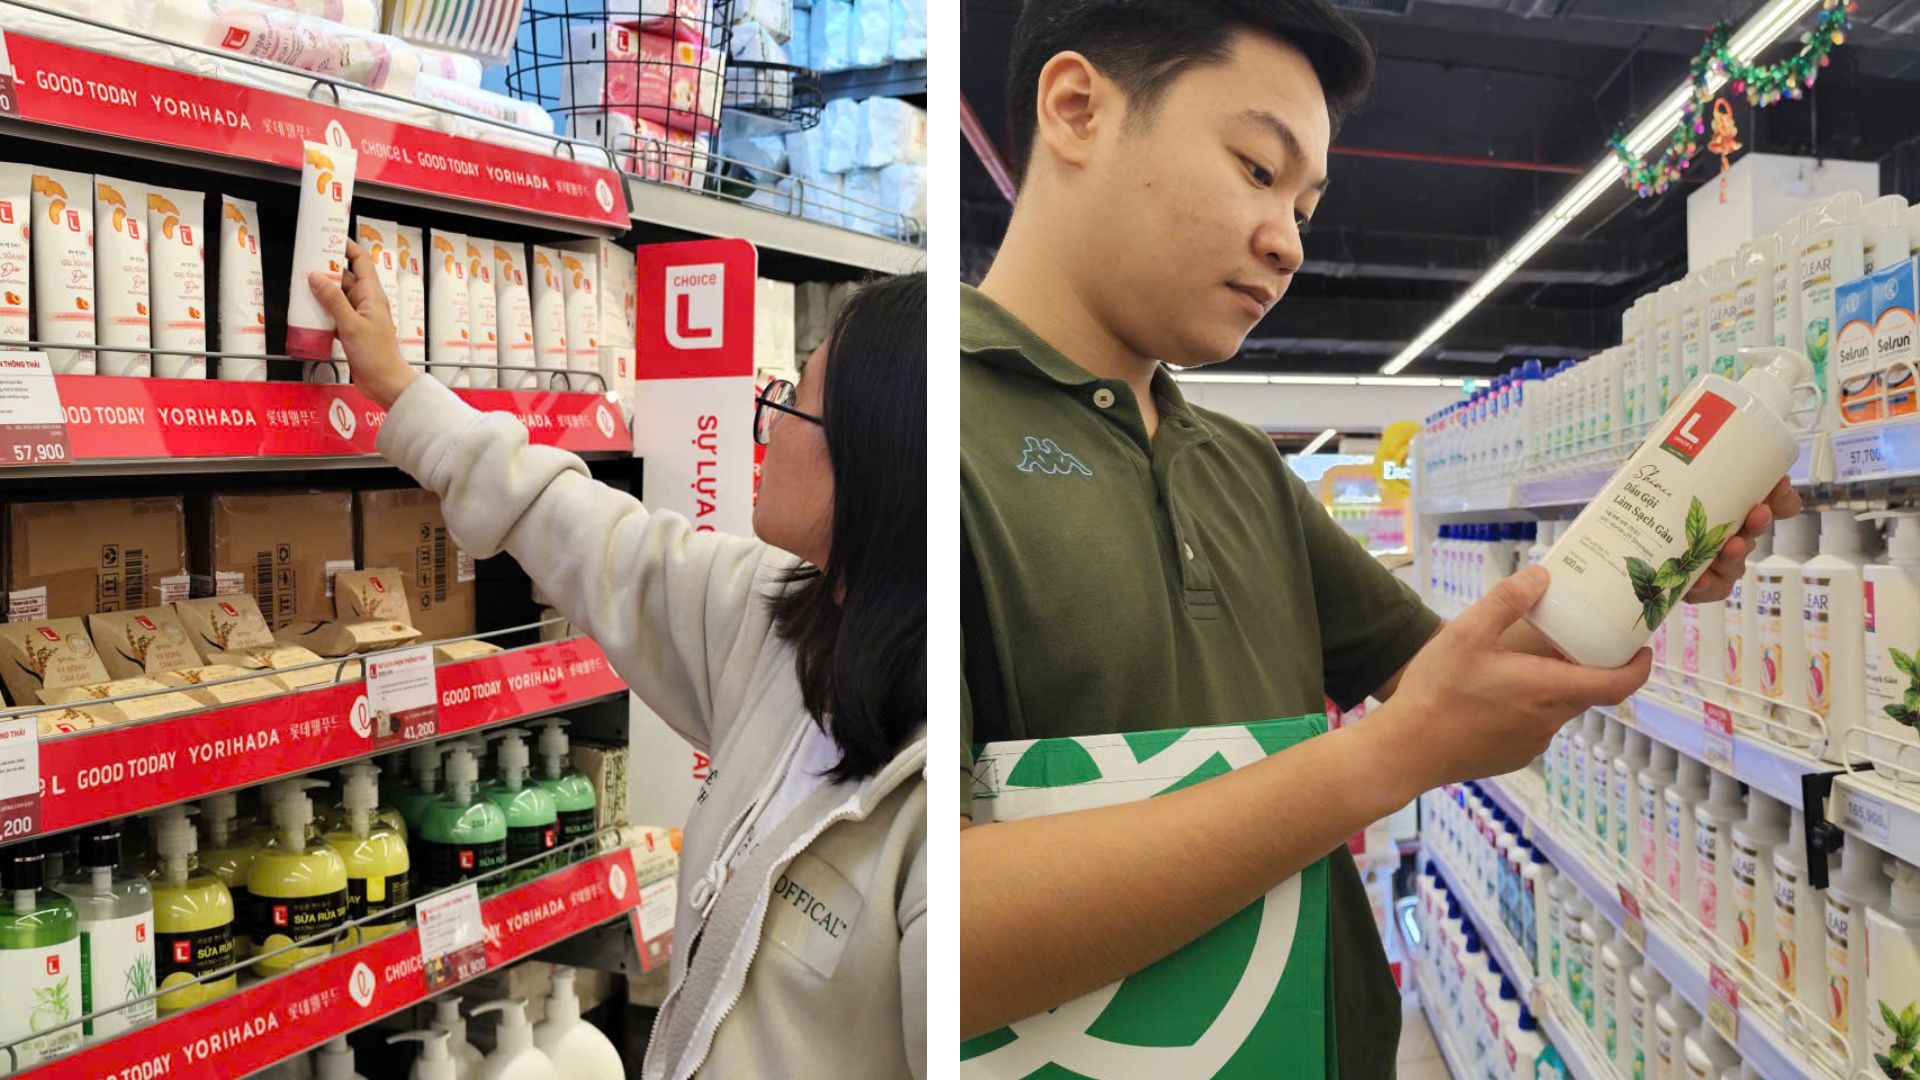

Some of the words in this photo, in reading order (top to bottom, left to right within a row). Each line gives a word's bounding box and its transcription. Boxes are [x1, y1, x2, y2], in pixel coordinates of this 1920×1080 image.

[11, 64, 25, 84] L
[37, 71, 83, 96] GOOD
[87, 81, 139, 107] TODAY
[151, 94, 251, 131] YORIHADA
[402, 149, 413, 163] L
[418, 153, 446, 170] GOOD
[448, 159, 479, 177] TODAY
[486, 165, 550, 191] YORIHADA
[676, 293, 712, 338] L
[1840, 344, 1869, 363] Selsun
[1877, 334, 1911, 353] Selsun
[94, 406, 145, 424] TODAY
[157, 407, 257, 427] YORIHADA
[692, 415, 718, 455] SỰ
[1680, 412, 1701, 444] L
[13, 443, 65, 463] 57,900
[691, 460, 718, 519] LỰA
[1640, 491, 1661, 509] Gội
[1612, 493, 1633, 512] Làm
[1631, 506, 1656, 529] Sạch
[1655, 522, 1675, 545] Gàu
[442, 688, 471, 706] GOOD
[473, 680, 501, 697] TODAY
[507, 666, 565, 691] YORIHADA
[404, 720, 435, 740] 41,200
[52, 775, 65, 795] L
[77, 762, 124, 790] GOOD
[128, 751, 177, 778] TODAY
[188, 728, 280, 764] YORIHADA
[507, 897, 565, 932] YORIHADA
[182, 1012, 279, 1064] YORIHADA
